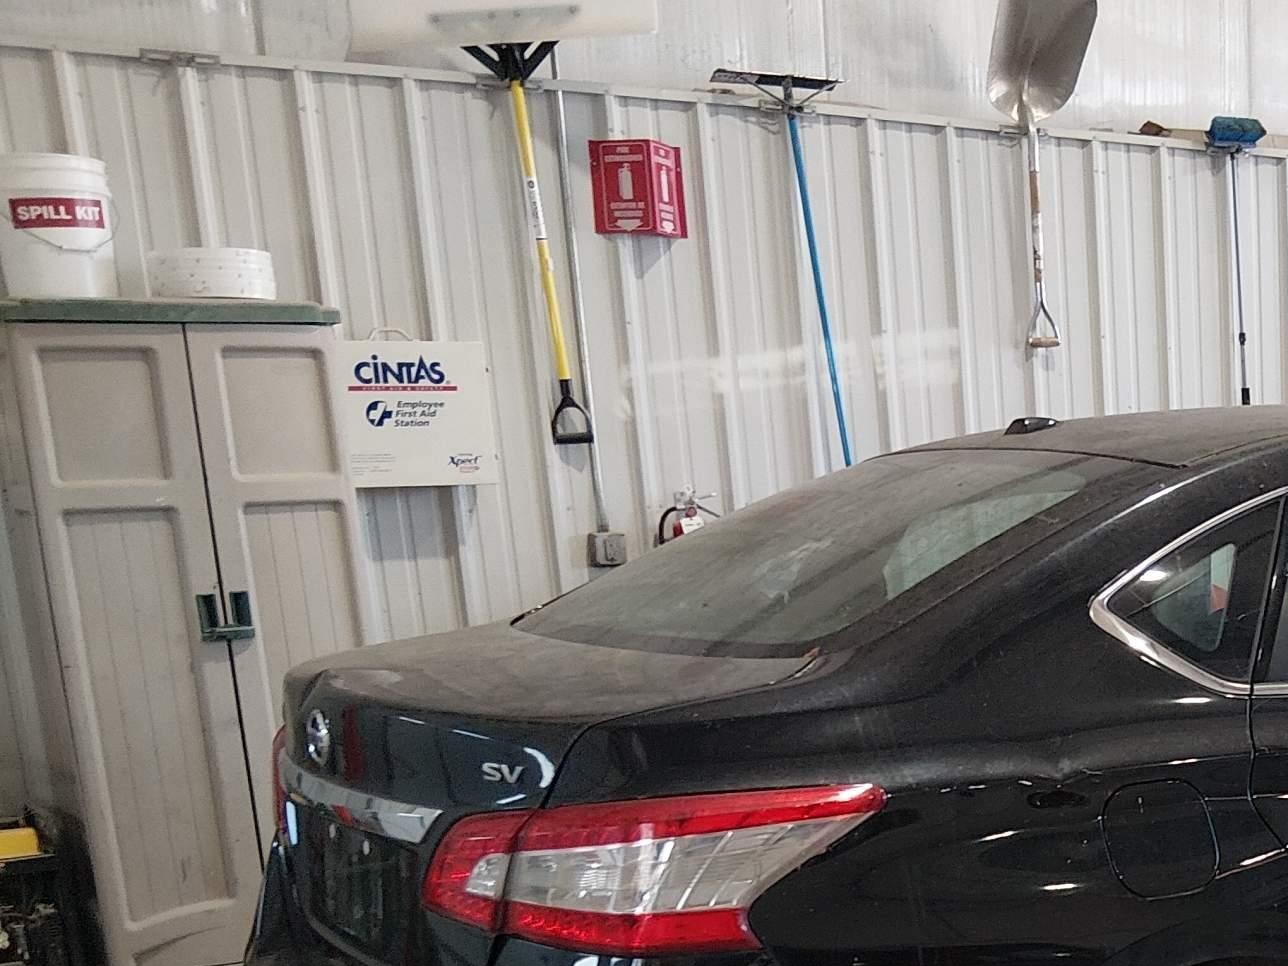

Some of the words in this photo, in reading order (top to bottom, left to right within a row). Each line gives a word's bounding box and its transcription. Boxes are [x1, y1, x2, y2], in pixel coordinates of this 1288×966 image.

[16, 205, 72, 220] SPILL
[75, 205, 100, 220] KIT
[396, 400, 445, 410] Employee
[395, 409, 417, 418] First
[419, 409, 437, 418] Aid
[393, 419, 430, 428] Station
[482, 762, 524, 784] SV
